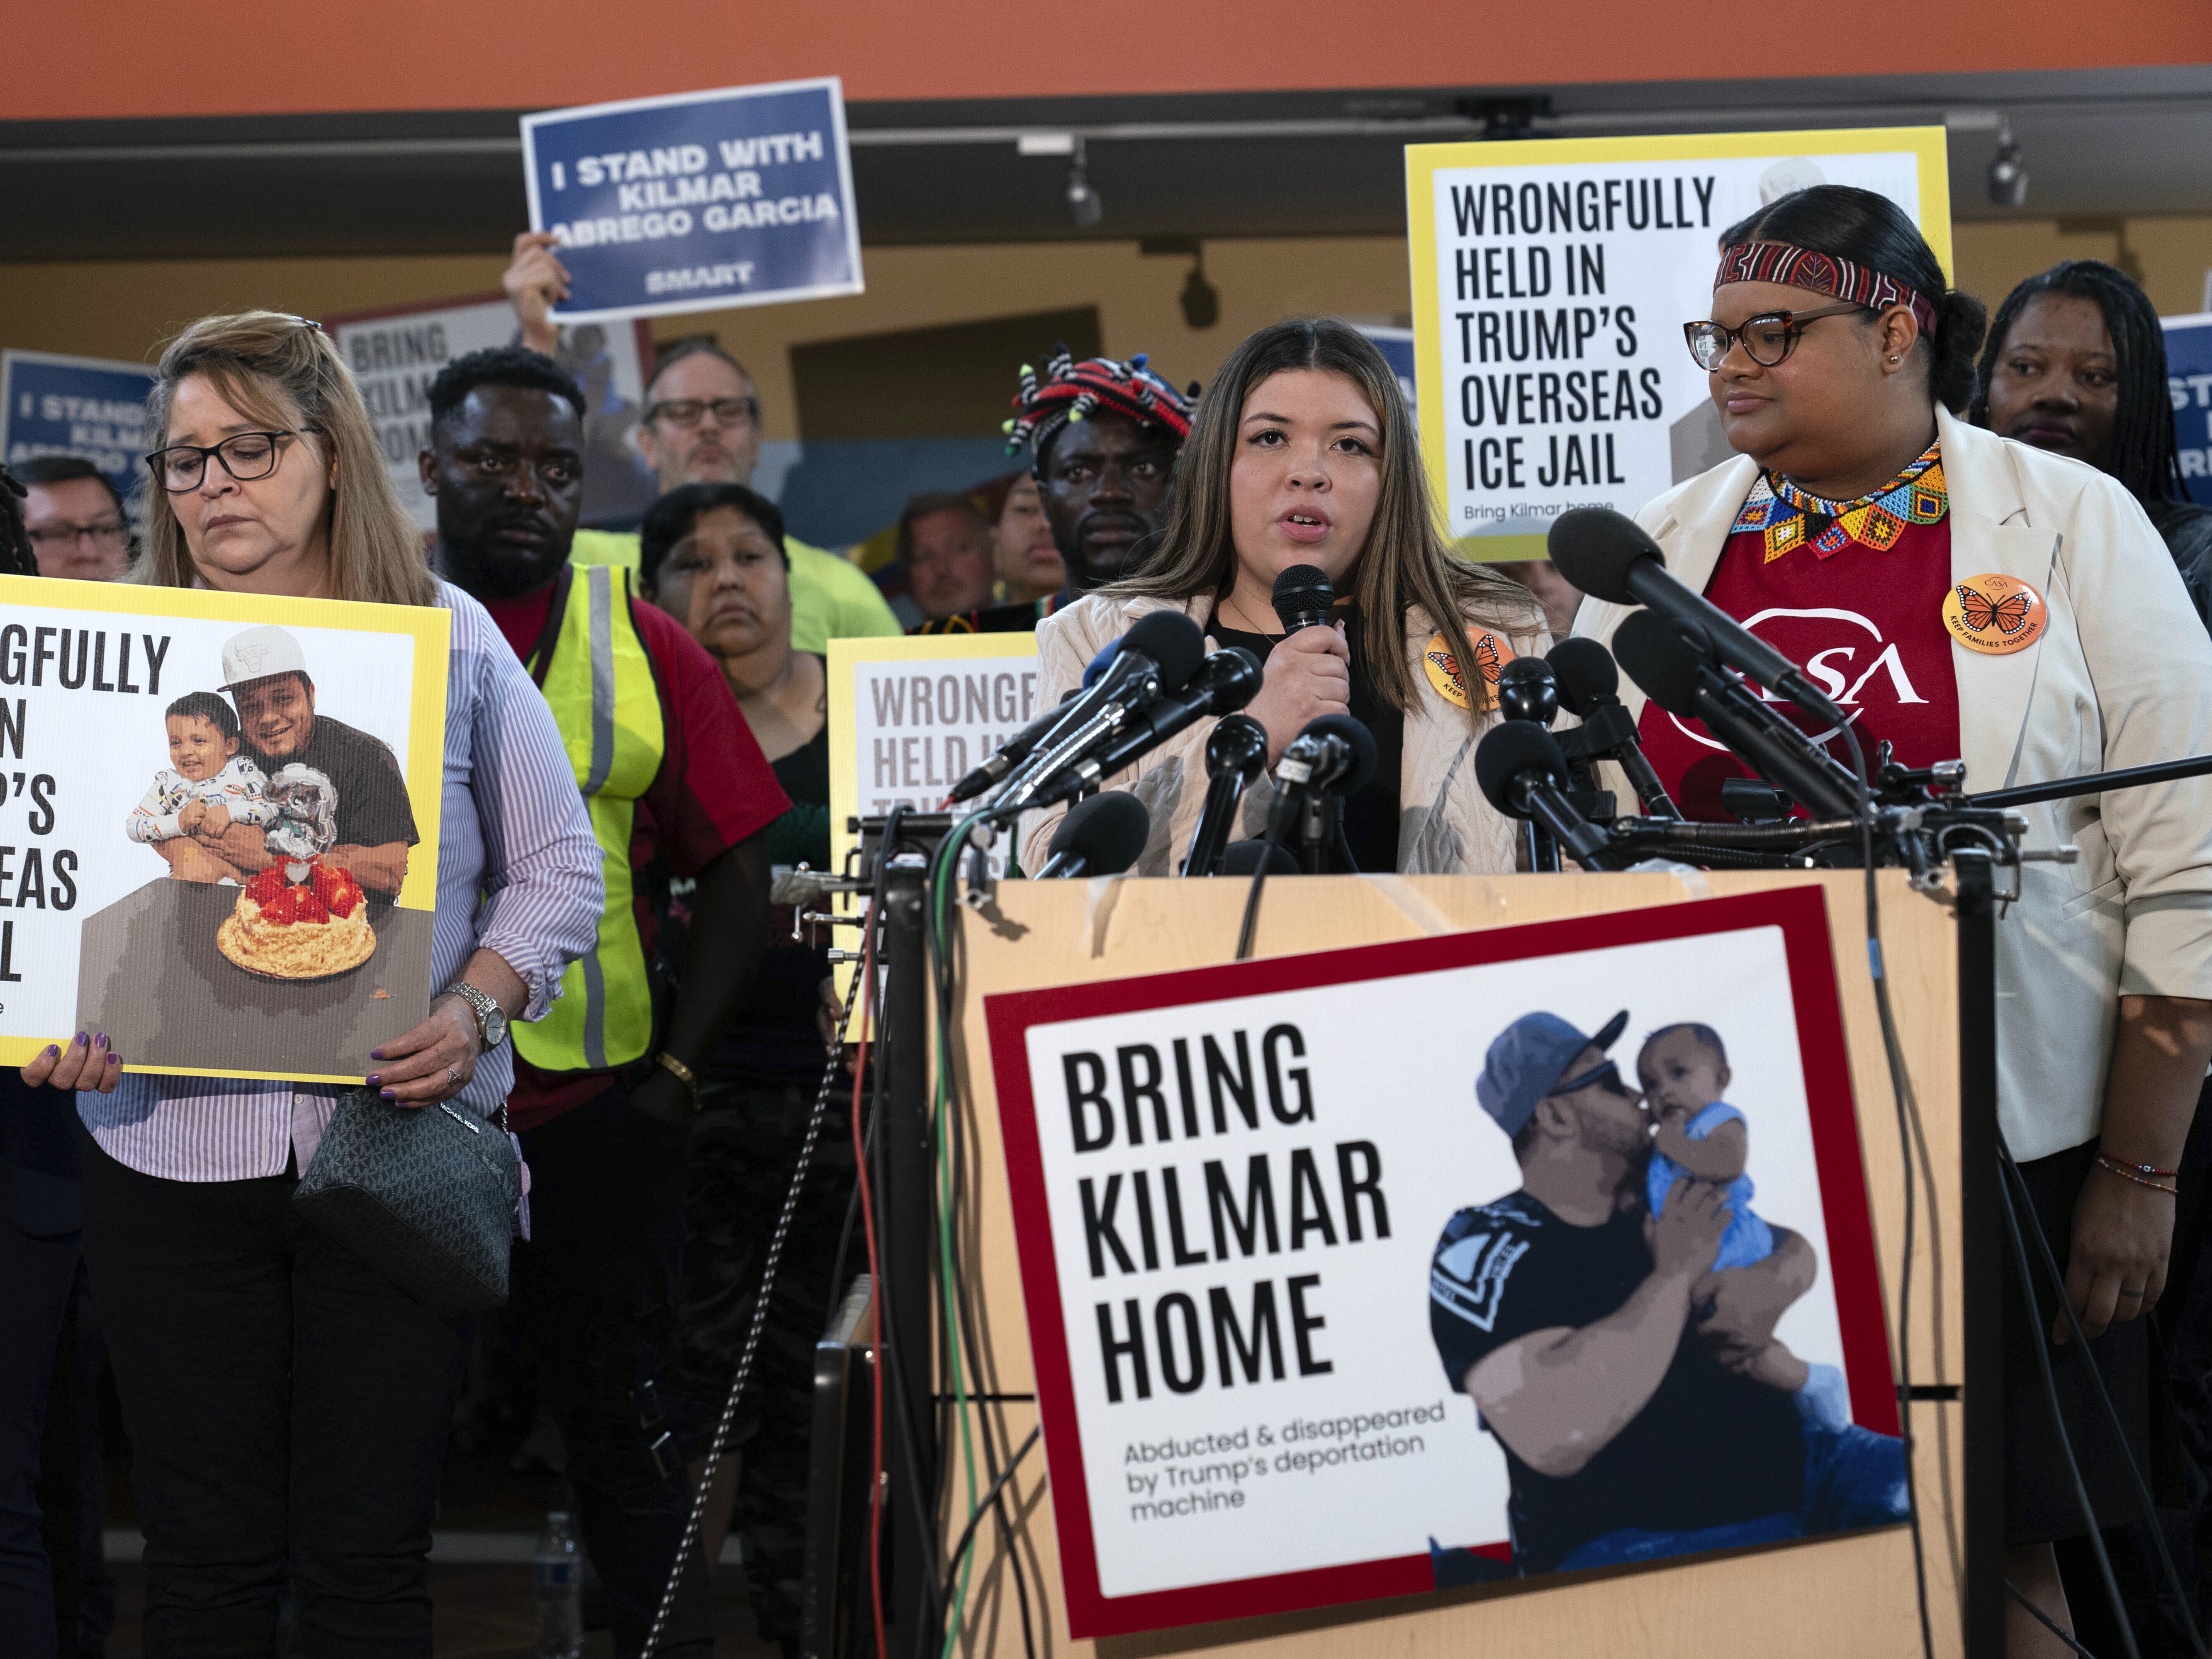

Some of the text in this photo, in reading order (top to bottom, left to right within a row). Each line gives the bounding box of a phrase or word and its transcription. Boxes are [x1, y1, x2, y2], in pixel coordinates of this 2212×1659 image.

[551, 131, 824, 191] I STAND WITH
[617, 170, 762, 212] KILMAR
[1450, 176, 1716, 237] WRONGFULLY
[550, 192, 841, 248] ABREGO GARCIA
[645, 260, 755, 294] SMART
[1455, 243, 1606, 301] HELD IN
[350, 322, 448, 373] BRING
[1455, 305, 1638, 364] TRUMP’S
[1460, 367, 1663, 427] OVERSEAS
[1464, 432, 1626, 491] ICE JAIL
[1464, 504, 1506, 523] Bring
[1510, 502, 1562, 518] Kilmar
[1984, 579, 2008, 588] CASA
[1950, 615, 2038, 647] KEEP FAMILIES TOGETHER
[1443, 683, 1462, 697] KEEP
[874, 735, 967, 788] HELD
[1061, 1022, 1316, 1154] BRING
[440, 1102, 479, 1134] MICHAEL KORS
[1078, 1139, 1392, 1280] KILMAR
[1095, 1273, 1334, 1404] HOME
[1124, 1399, 1447, 1466] Abducted & disappeared
[1126, 1432, 1426, 1498] by Trump’s deportation
[1131, 1489, 1246, 1523] machine
